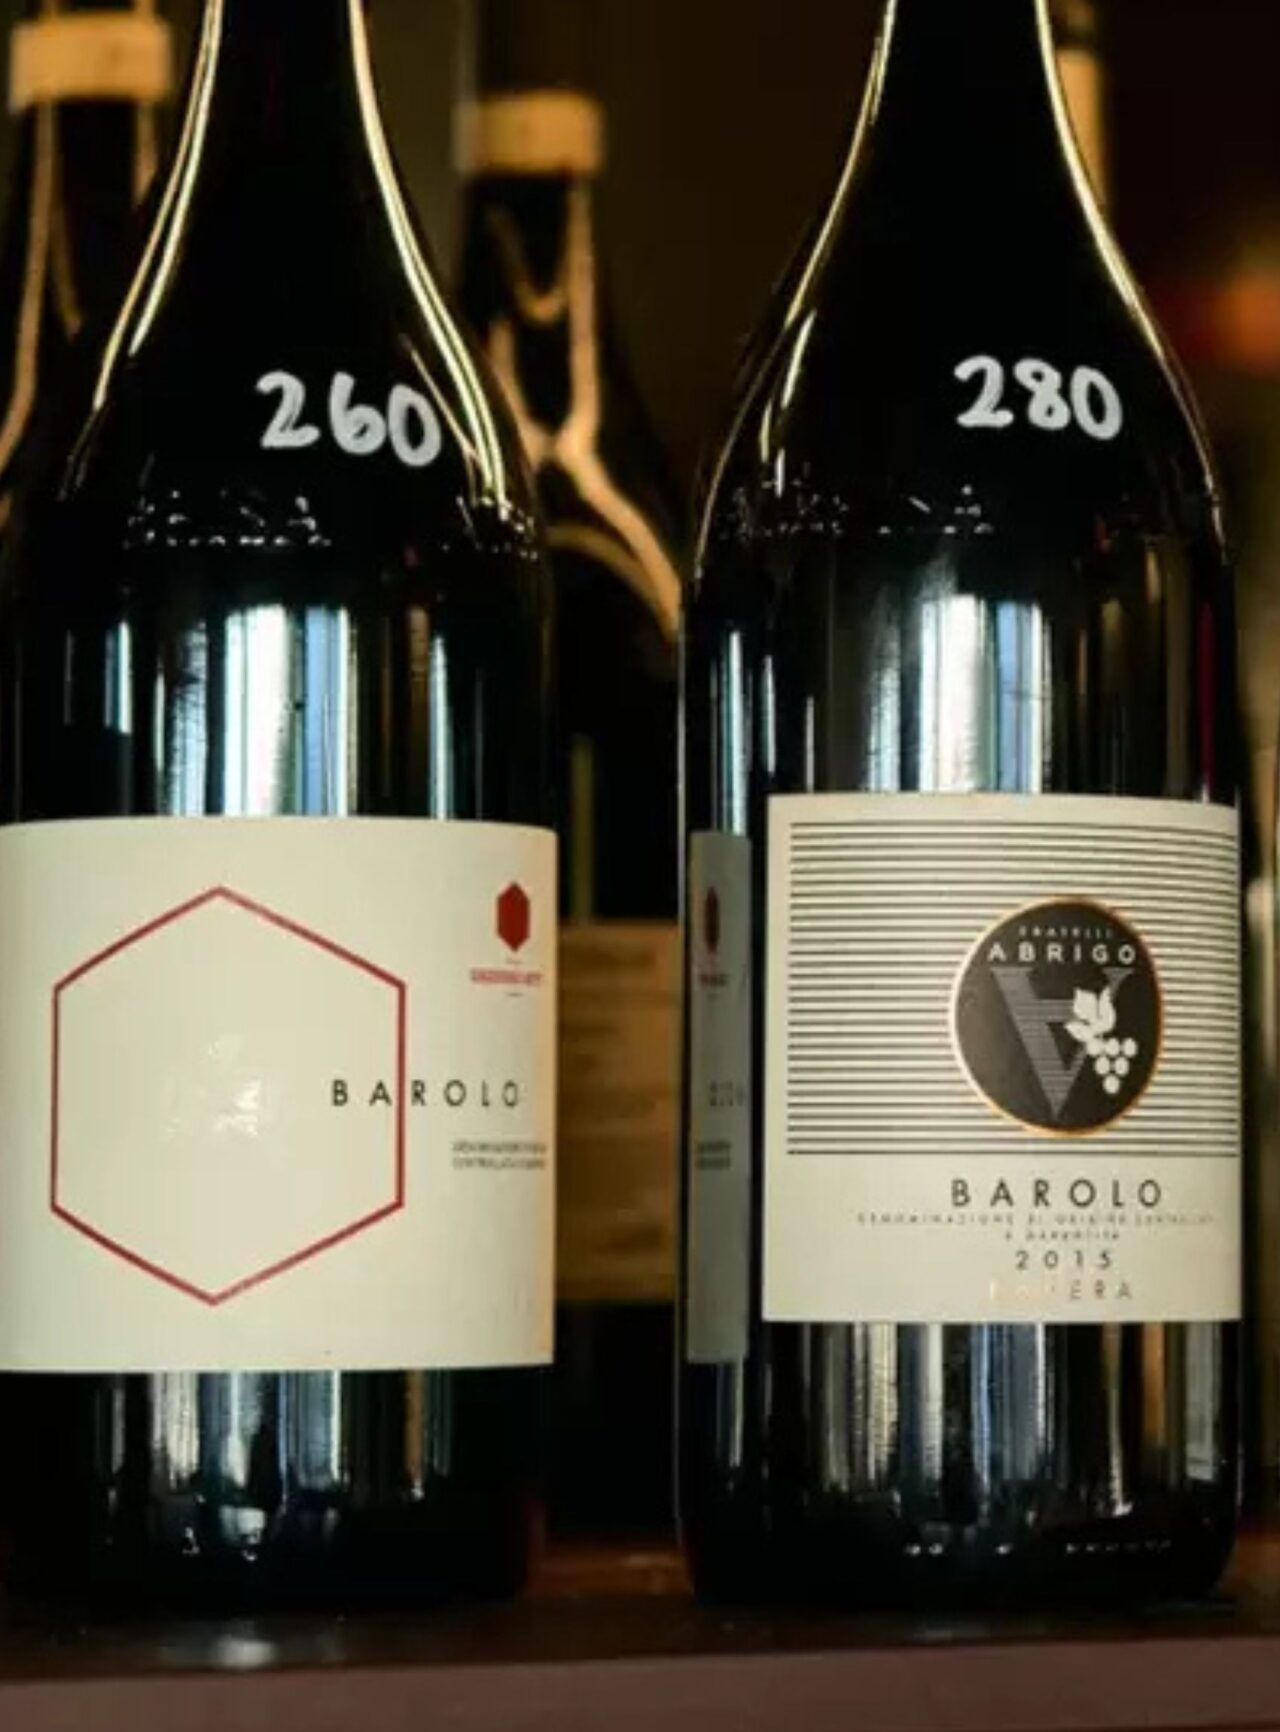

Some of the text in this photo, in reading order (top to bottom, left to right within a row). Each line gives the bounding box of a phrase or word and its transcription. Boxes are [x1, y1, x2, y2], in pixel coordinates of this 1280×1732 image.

[954, 355, 1123, 441] 280
[257, 370, 442, 468] 260
[987, 943, 1136, 963] ABRIGO
[331, 1079, 520, 1107] BAROLO
[950, 1178, 1163, 1208] BAROLO
[1016, 1250, 1113, 1271] 2015
